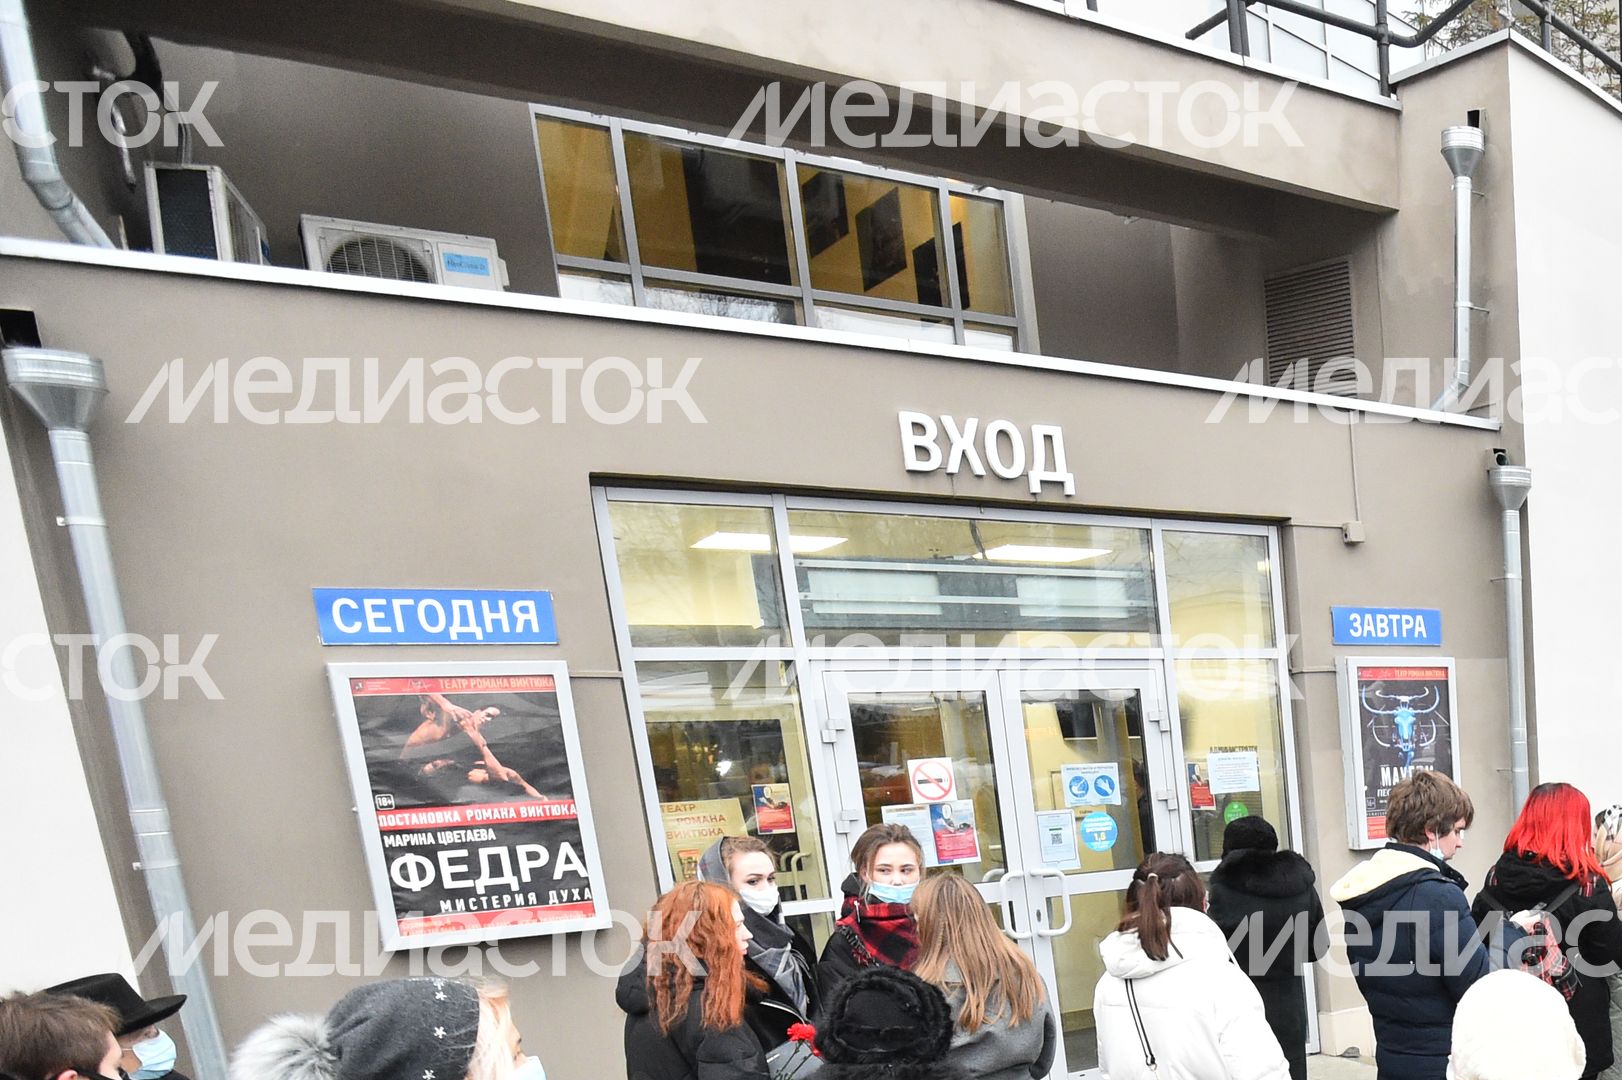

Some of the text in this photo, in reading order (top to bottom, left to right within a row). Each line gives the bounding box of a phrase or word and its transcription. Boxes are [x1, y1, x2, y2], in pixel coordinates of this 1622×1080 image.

[899, 410, 1075, 497] ВХОД
[332, 597, 539, 641] СЕГОДНЯ
[1348, 612, 1427, 639] ЗАВТРА
[439, 678, 467, 690] ТЕАТР
[469, 677, 509, 689] РОМАНА
[377, 797, 393, 807] 18+
[660, 803, 696, 813] ТЕАТР
[378, 803, 579, 828] ПОСТАНОВКА РОМАНА ВИКТЮКА
[676, 814, 726, 825] РОМАНА
[383, 828, 496, 848] МАРИНА ЦВЕТАЕВА
[666, 827, 725, 840] ВИКТЮКА
[390, 841, 589, 895] ФЕДРА
[440, 887, 593, 914] МИСТЕРИЯ ДУХА
